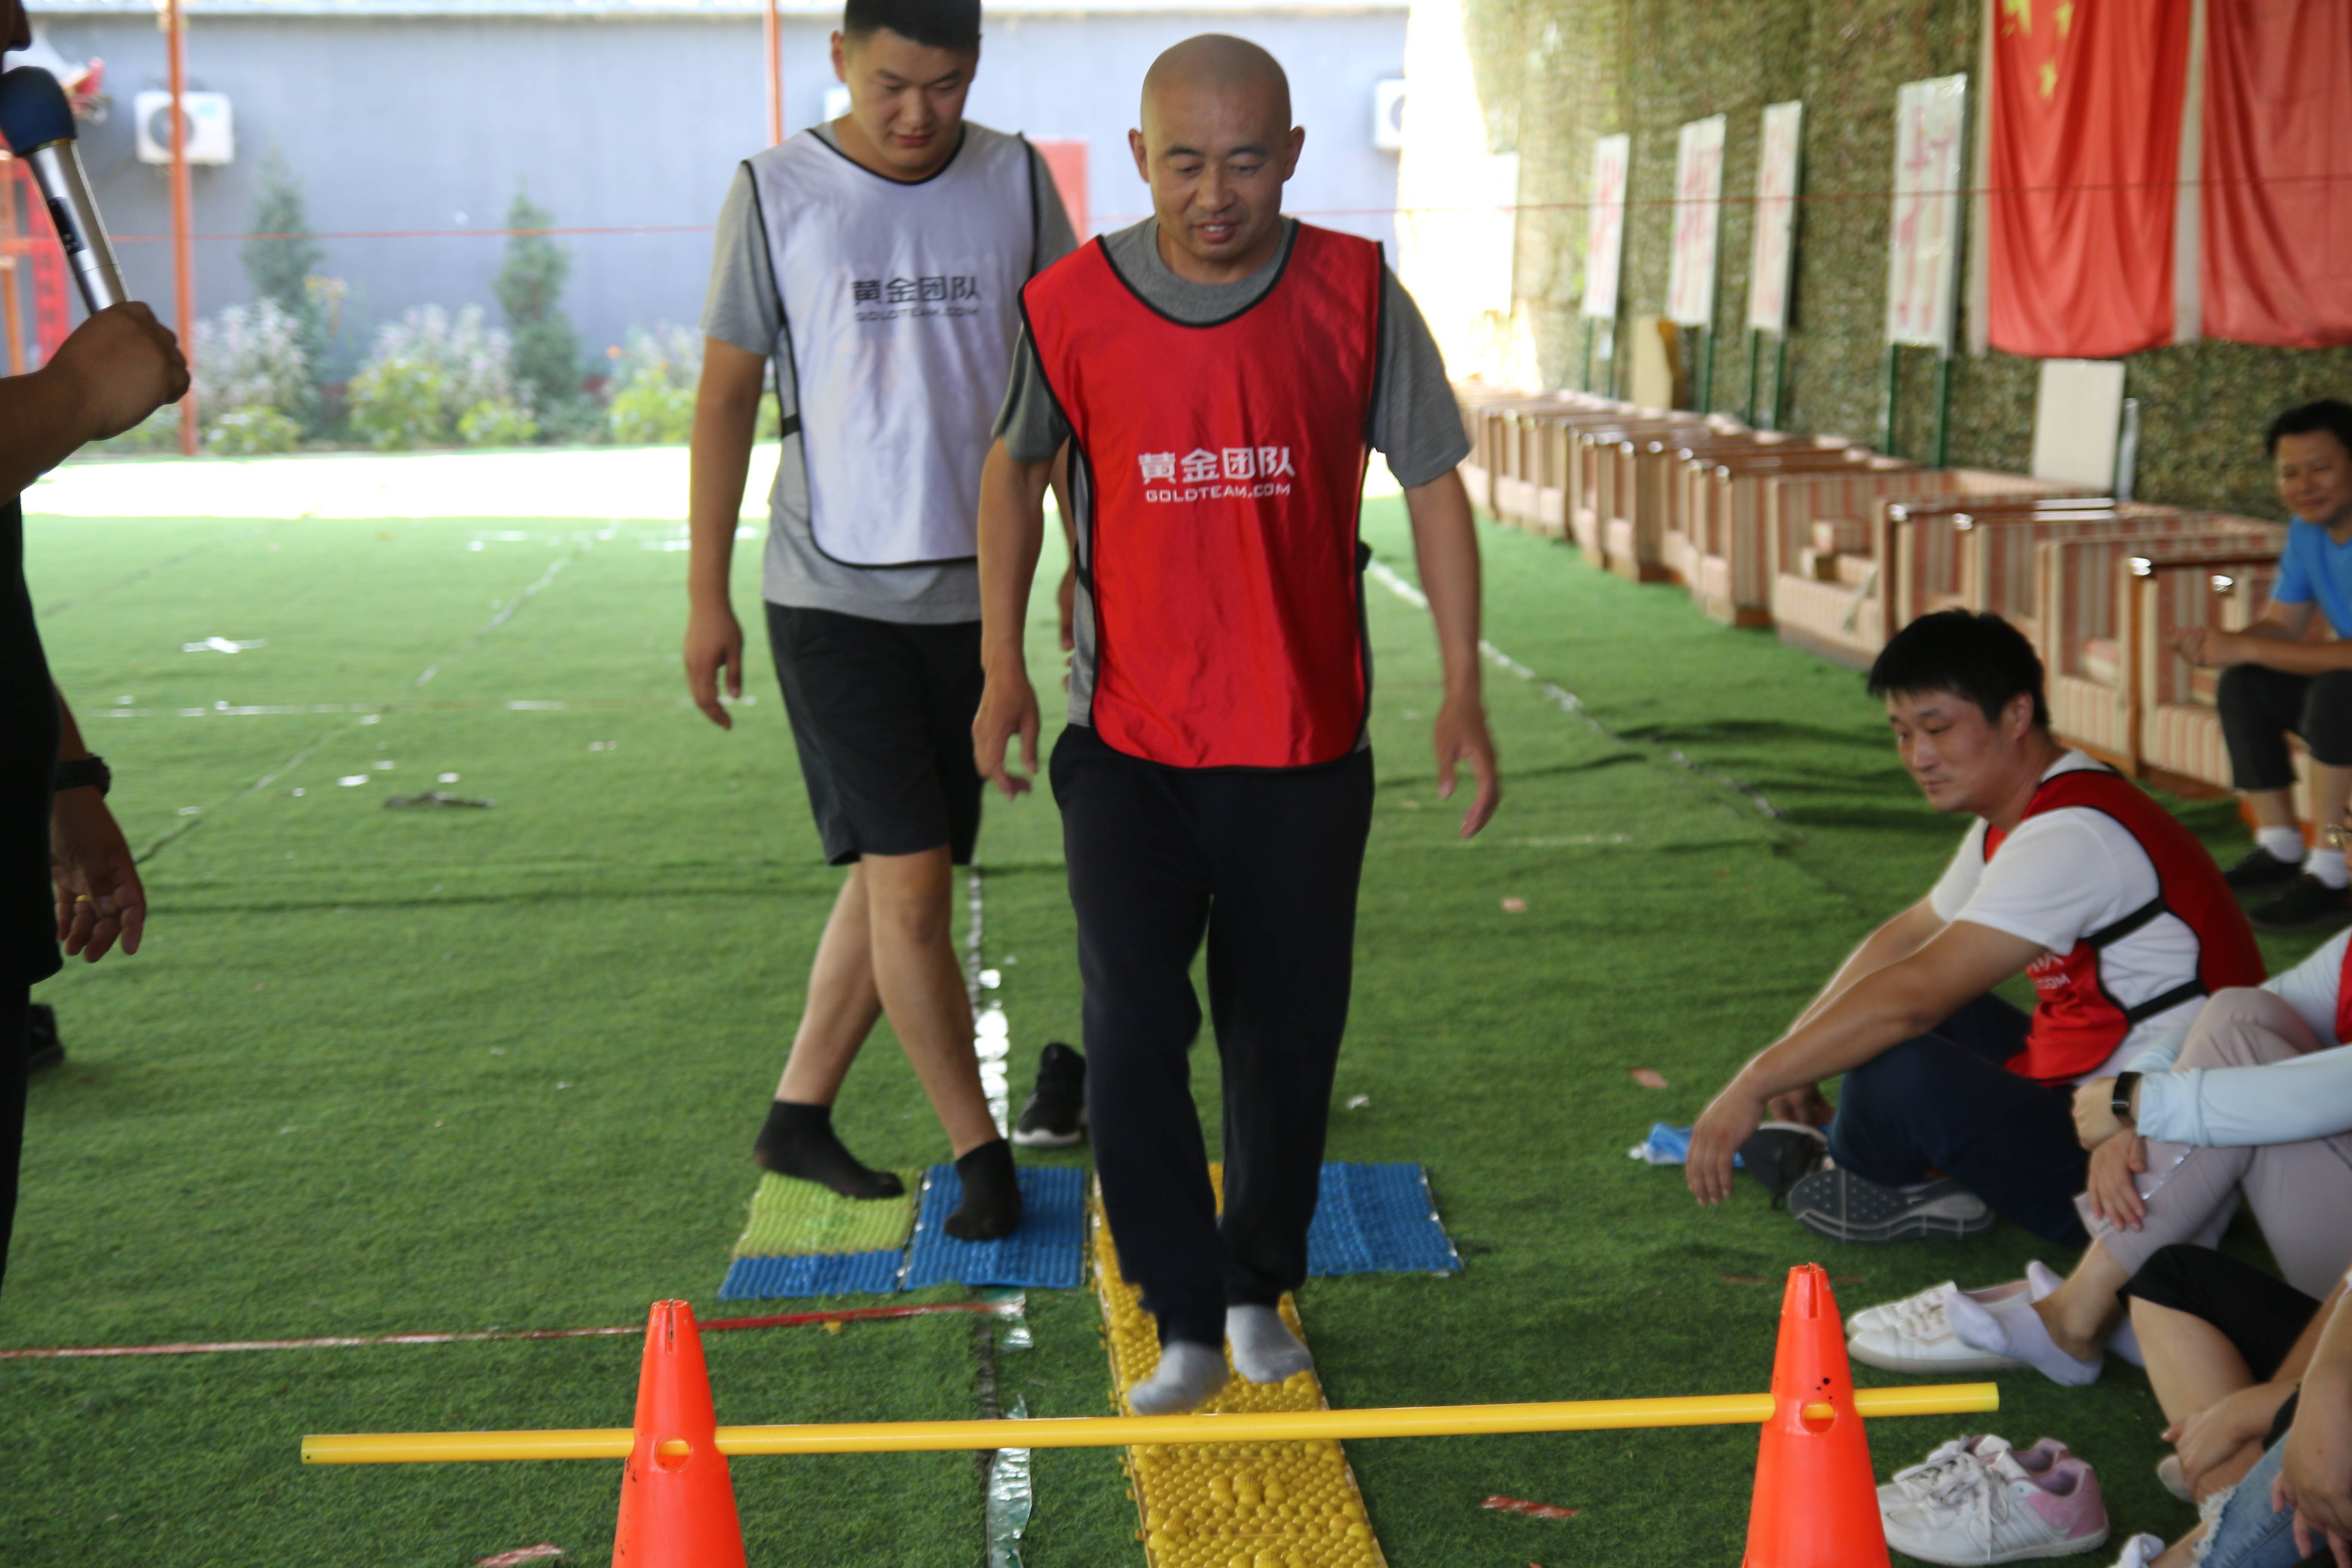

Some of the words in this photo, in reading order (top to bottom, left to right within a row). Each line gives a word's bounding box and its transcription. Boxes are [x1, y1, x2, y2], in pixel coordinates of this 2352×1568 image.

[852, 276, 982, 306] 黄金团队
[1139, 446, 1295, 484] 黄金团队
[1145, 483, 1291, 502] GOLDTEAM.COM
